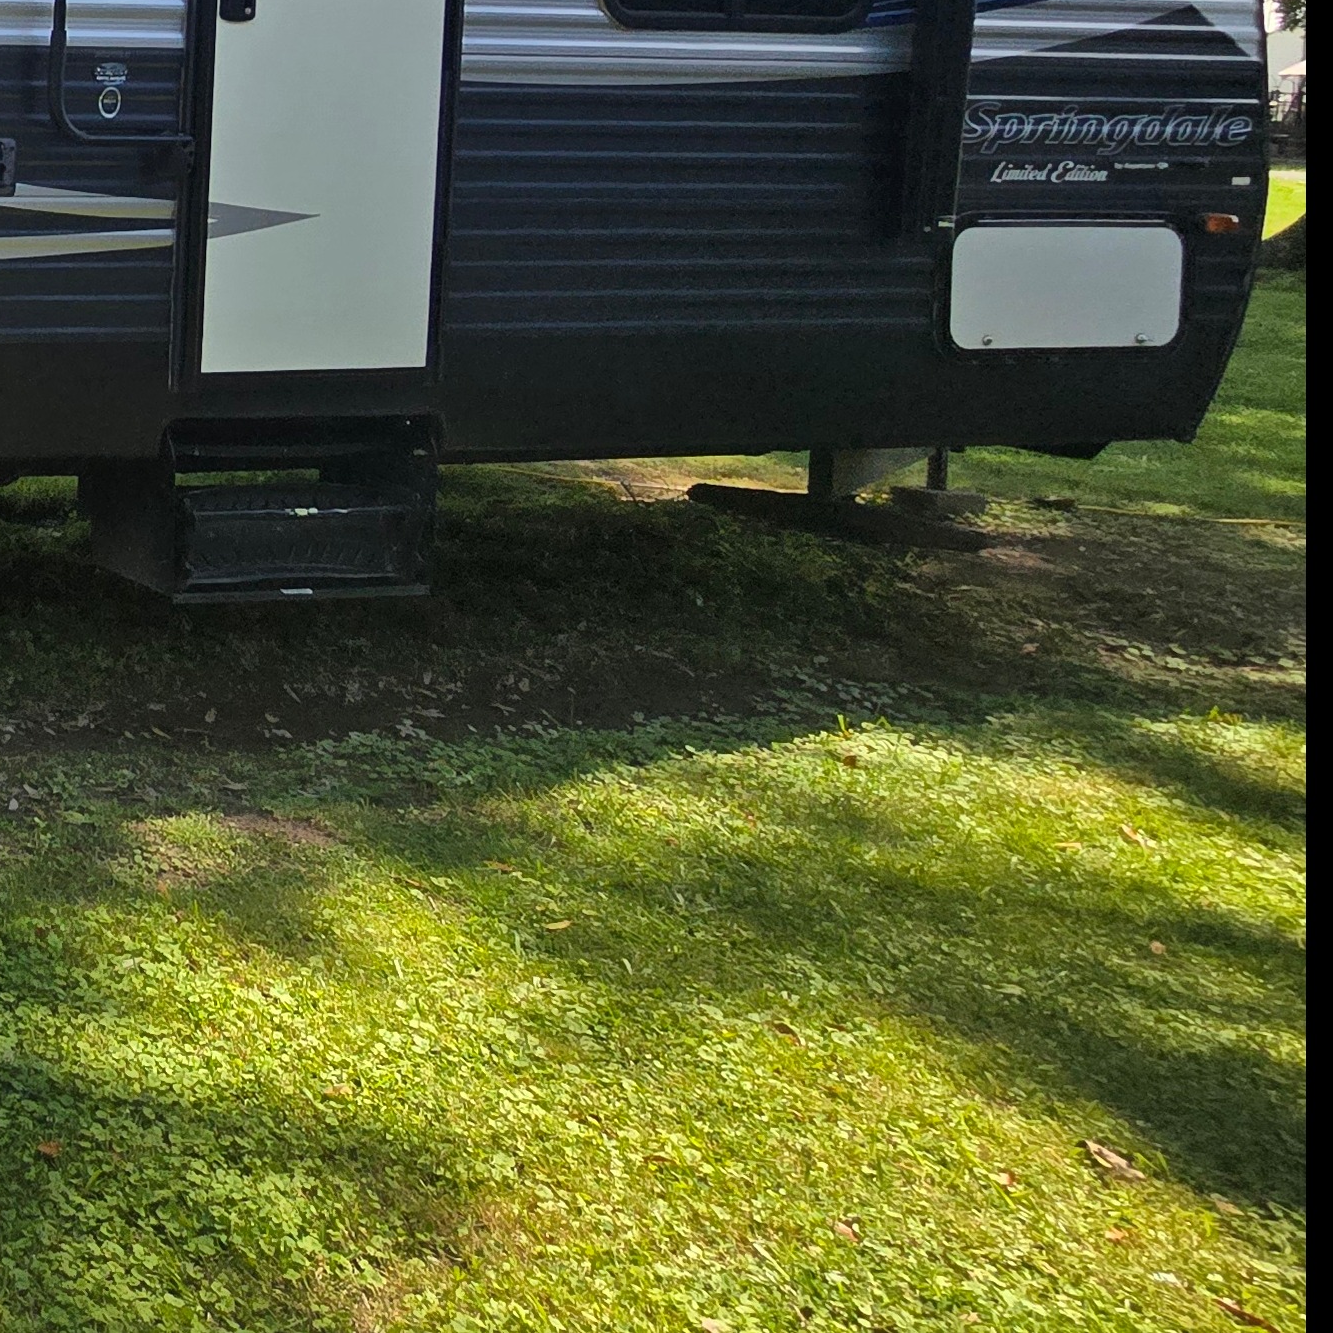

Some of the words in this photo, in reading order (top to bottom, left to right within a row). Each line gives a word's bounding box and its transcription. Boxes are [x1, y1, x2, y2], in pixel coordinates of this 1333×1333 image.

[962, 101, 1253, 154] Springdale
[990, 161, 1052, 183] Limited
[1050, 160, 1108, 183] Edition
